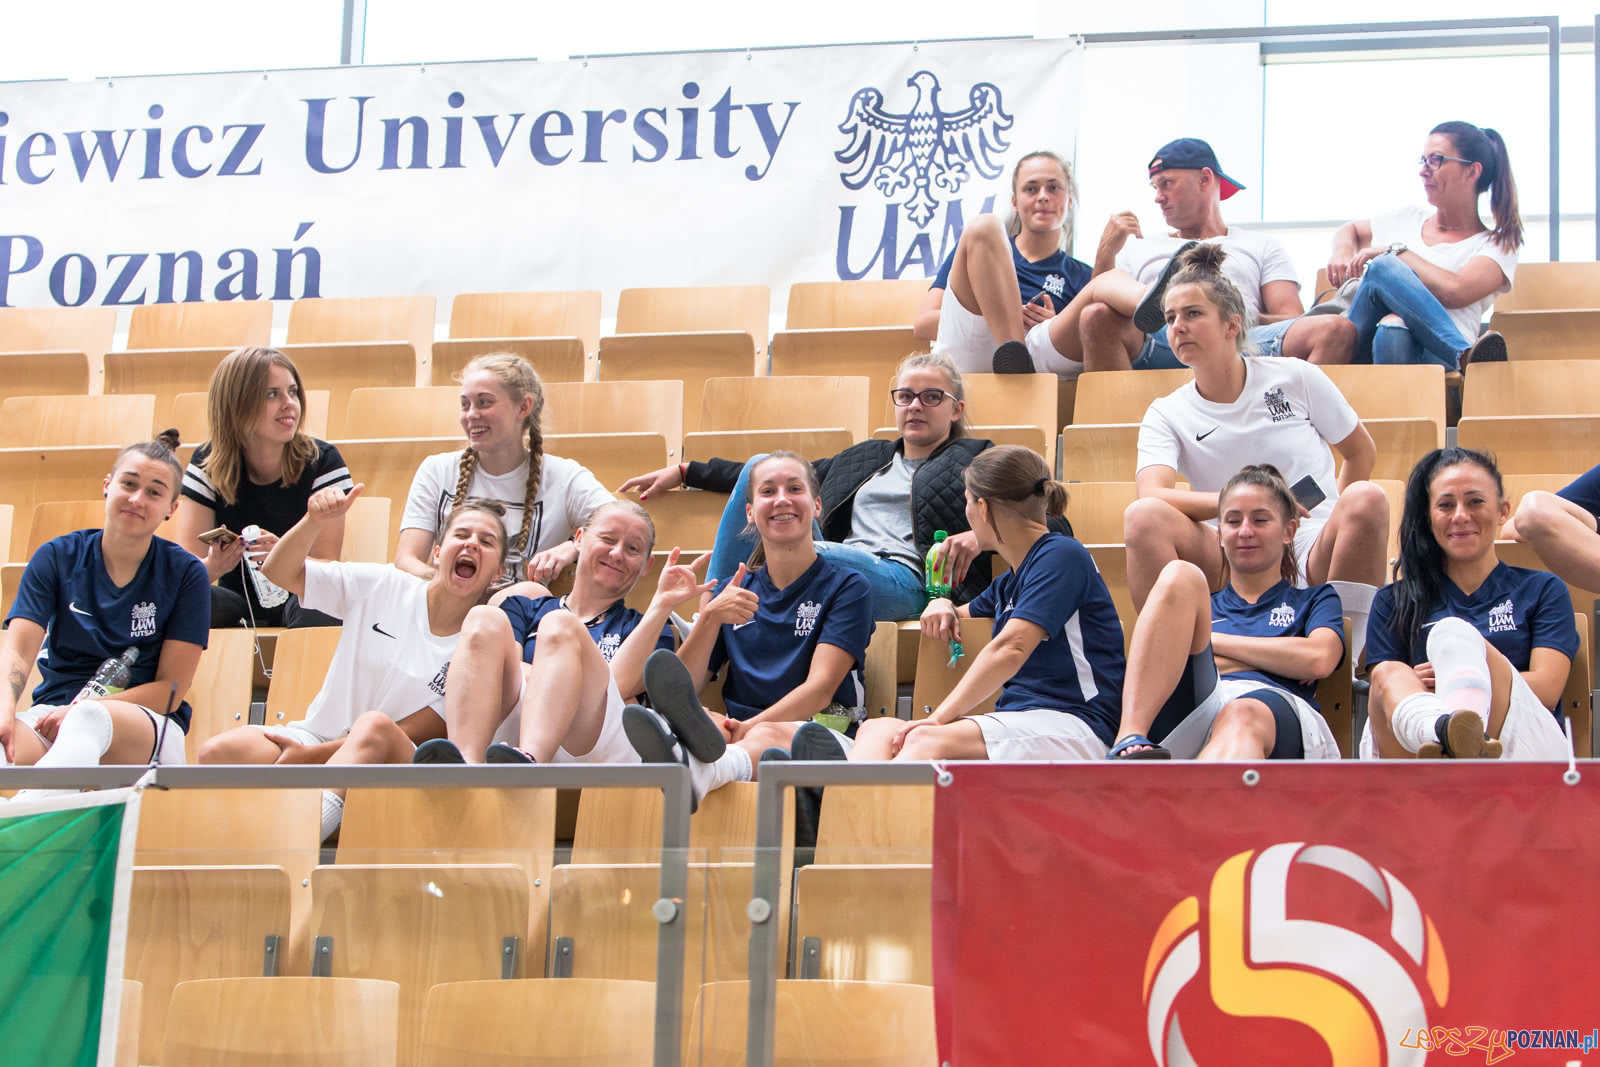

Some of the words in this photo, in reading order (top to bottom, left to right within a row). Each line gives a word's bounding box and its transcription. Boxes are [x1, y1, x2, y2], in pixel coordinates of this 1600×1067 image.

[0, 104, 266, 186] iewicz
[302, 82, 801, 182] University
[0, 220, 322, 307] Poznań
[1268, 401, 1292, 416] UAM
[1272, 412, 1296, 423] FUTSAL
[131, 616, 156, 631] UAM
[1488, 614, 1514, 627] UAM
[1488, 624, 1518, 633] FUTSAL
